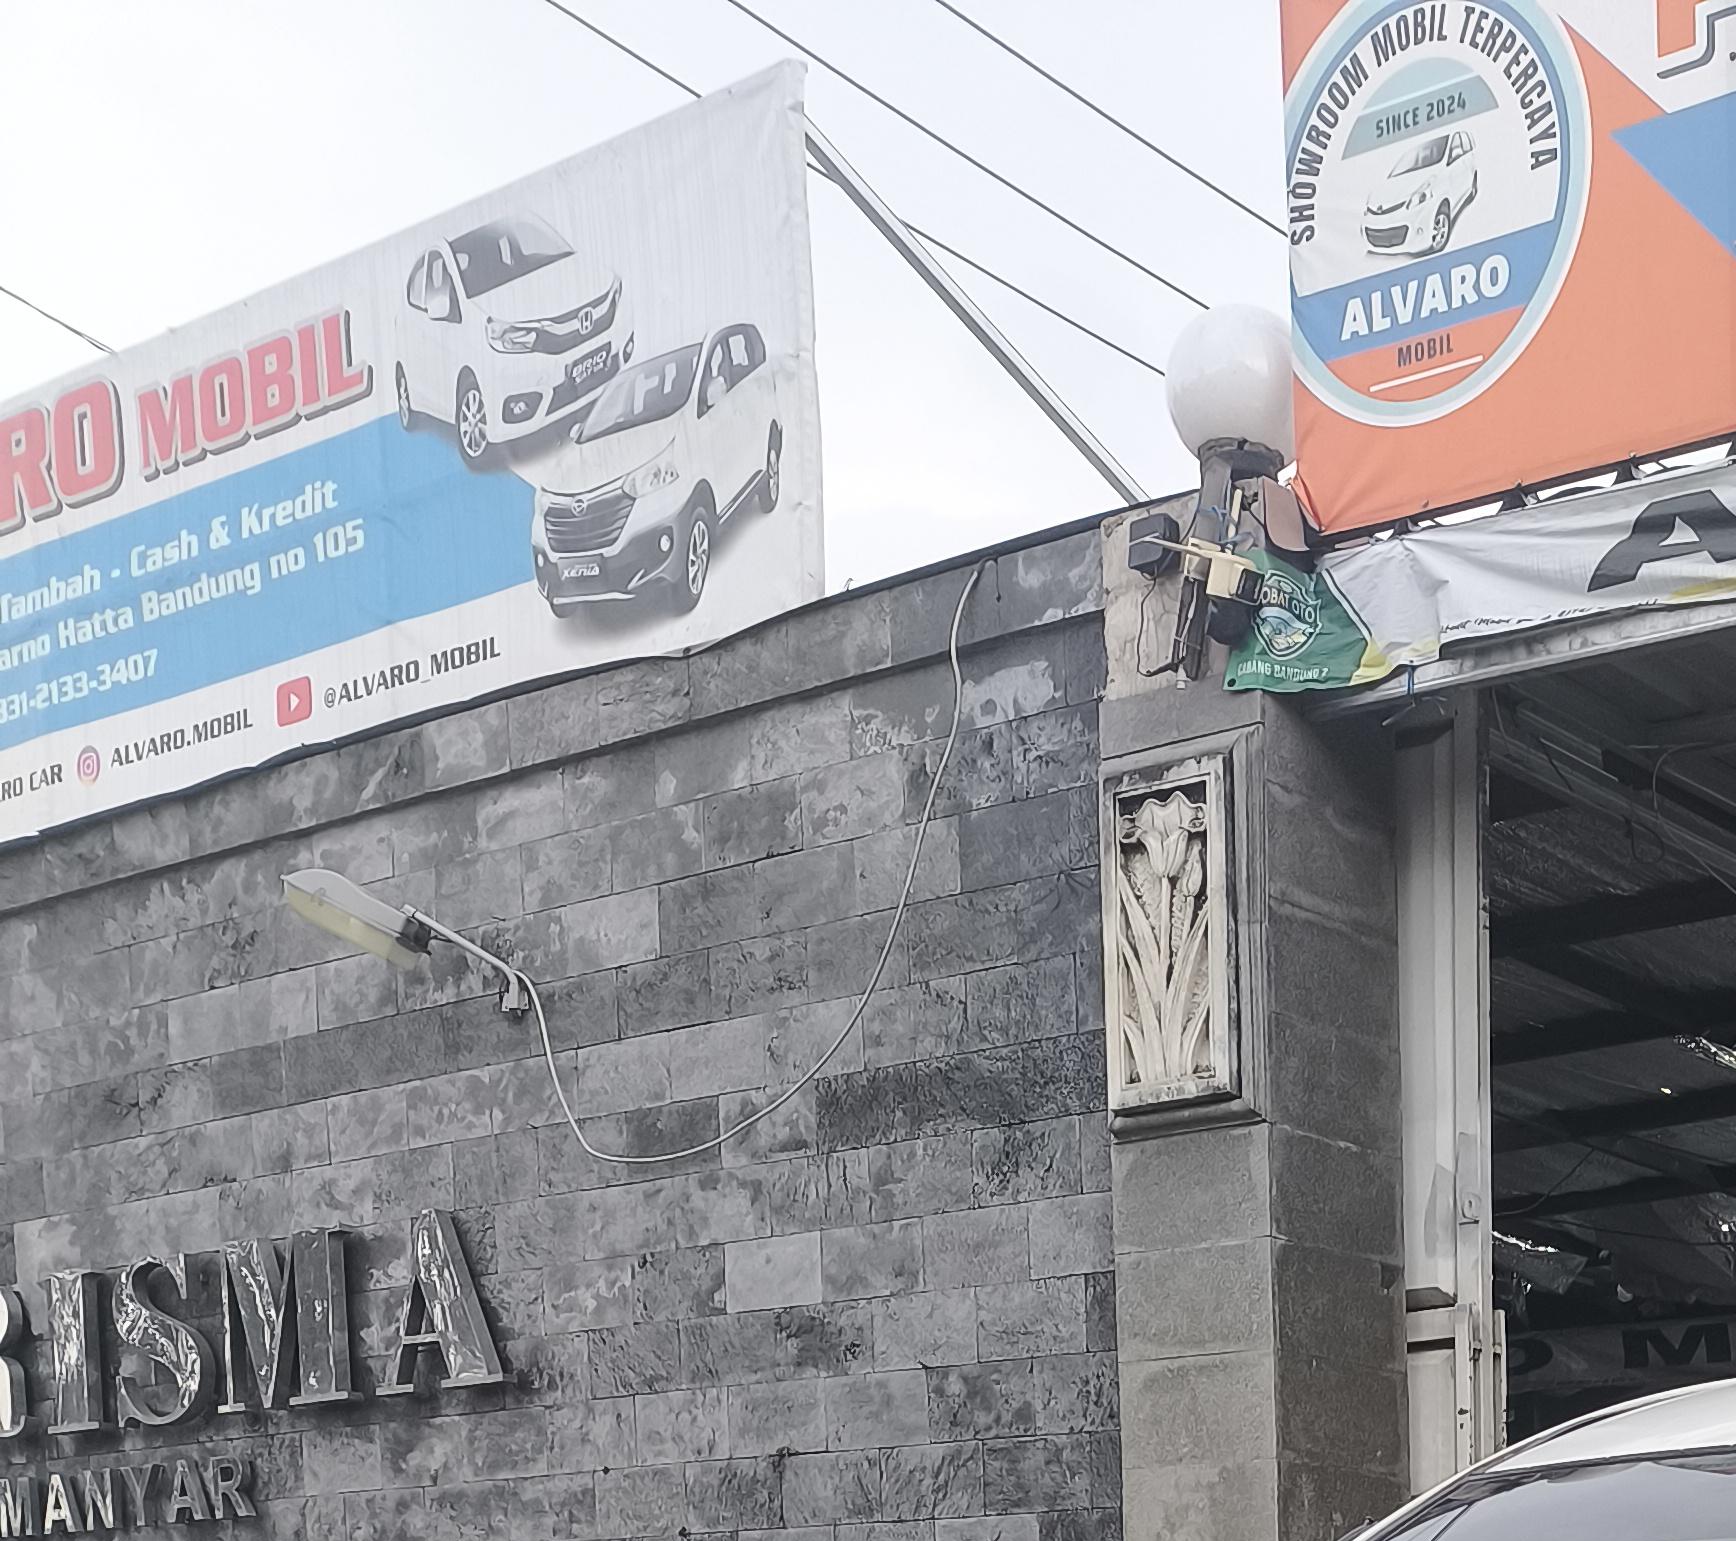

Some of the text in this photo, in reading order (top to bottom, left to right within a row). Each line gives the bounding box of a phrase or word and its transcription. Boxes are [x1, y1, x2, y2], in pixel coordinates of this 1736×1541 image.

[1289, 52, 1370, 246] SHOWROOM
[1370, 3, 1448, 68] MOBIL
[1458, 5, 1558, 171] TERPERCAYA
[1375, 91, 1467, 138] SINCE 2024
[1339, 254, 1511, 341] ALVARO
[1396, 333, 1455, 369] MOBIL
[136, 309, 373, 481] MOBIL
[0, 563, 101, 624] Tambah
[130, 529, 199, 577] Cash
[208, 515, 232, 550] &
[241, 480, 339, 539] Kredit
[58, 605, 135, 649] Hatta
[141, 561, 262, 623] Bandung
[269, 546, 306, 579] no
[313, 518, 366, 563] 105
[1291, 600, 1315, 623] OTO
[322, 636, 502, 710] @ALVARO_MOBIL
[110, 707, 254, 769] ALVARO.MOBIL
[1, 763, 63, 801] RO CAR
